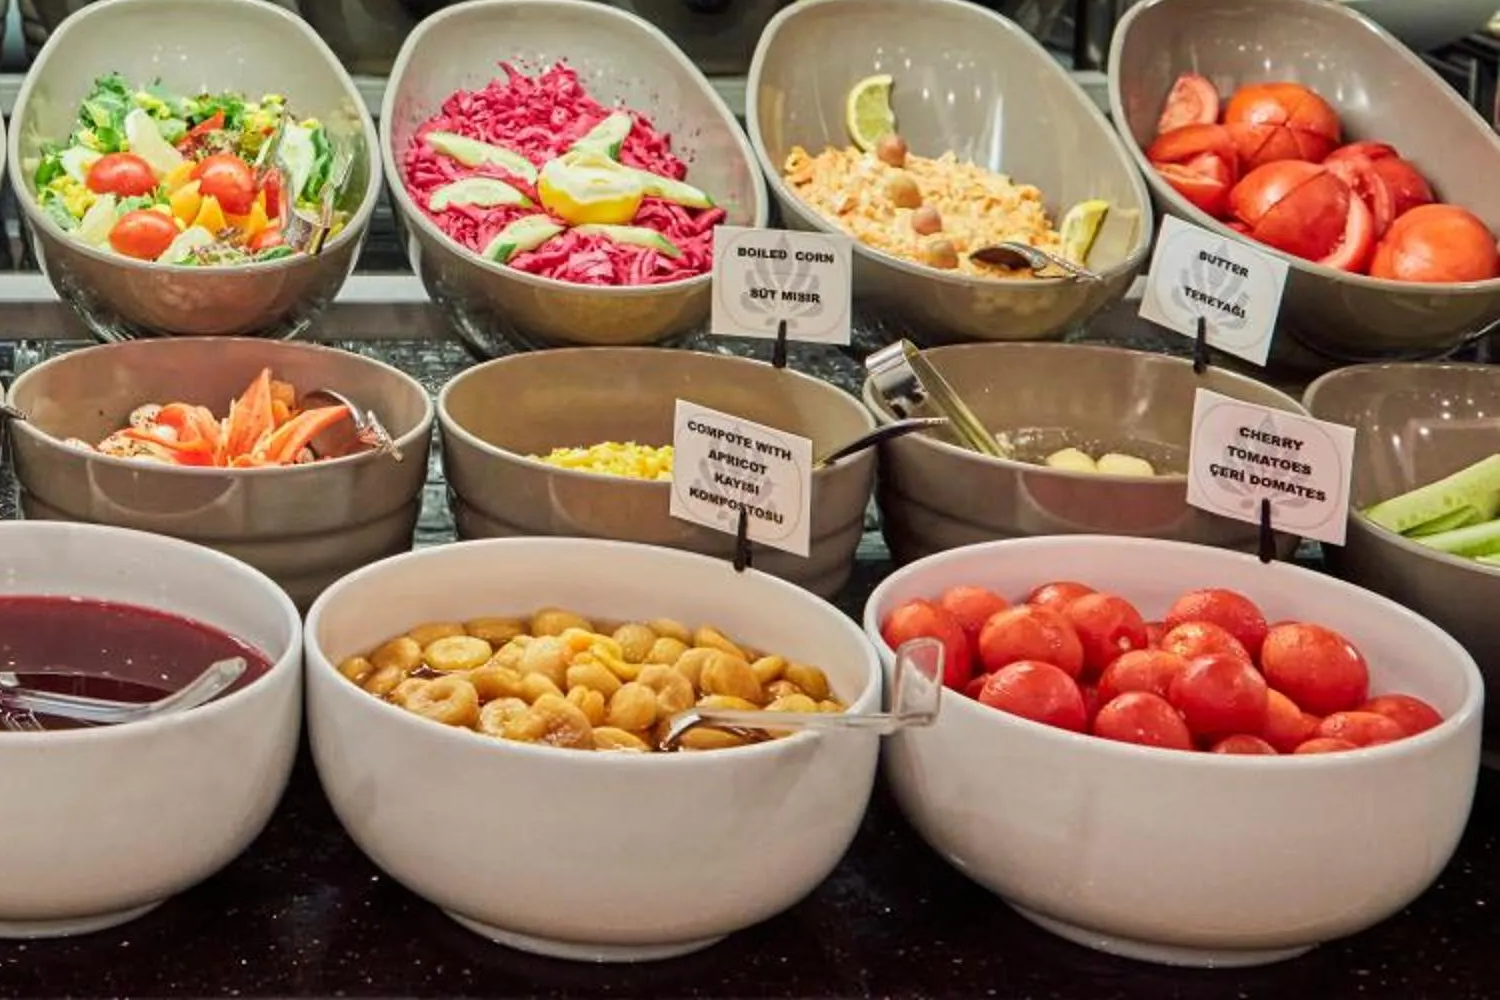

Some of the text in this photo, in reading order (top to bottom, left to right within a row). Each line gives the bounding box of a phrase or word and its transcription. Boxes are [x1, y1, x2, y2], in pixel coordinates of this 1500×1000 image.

[737, 248, 835, 263] BOILED CORN
[1199, 250, 1249, 278] BUTTER
[781, 291, 821, 303] MISIR
[1184, 286, 1246, 319] TEREYAĞI
[687, 420, 791, 460] COMPOTE WITH
[1239, 427, 1305, 451] CHERRY
[708, 449, 767, 475] APRICOT
[1227, 446, 1312, 474] TOMATOES
[714, 473, 759, 495] KAYISI
[1210, 462, 1327, 502] ÇERİ DOMATES
